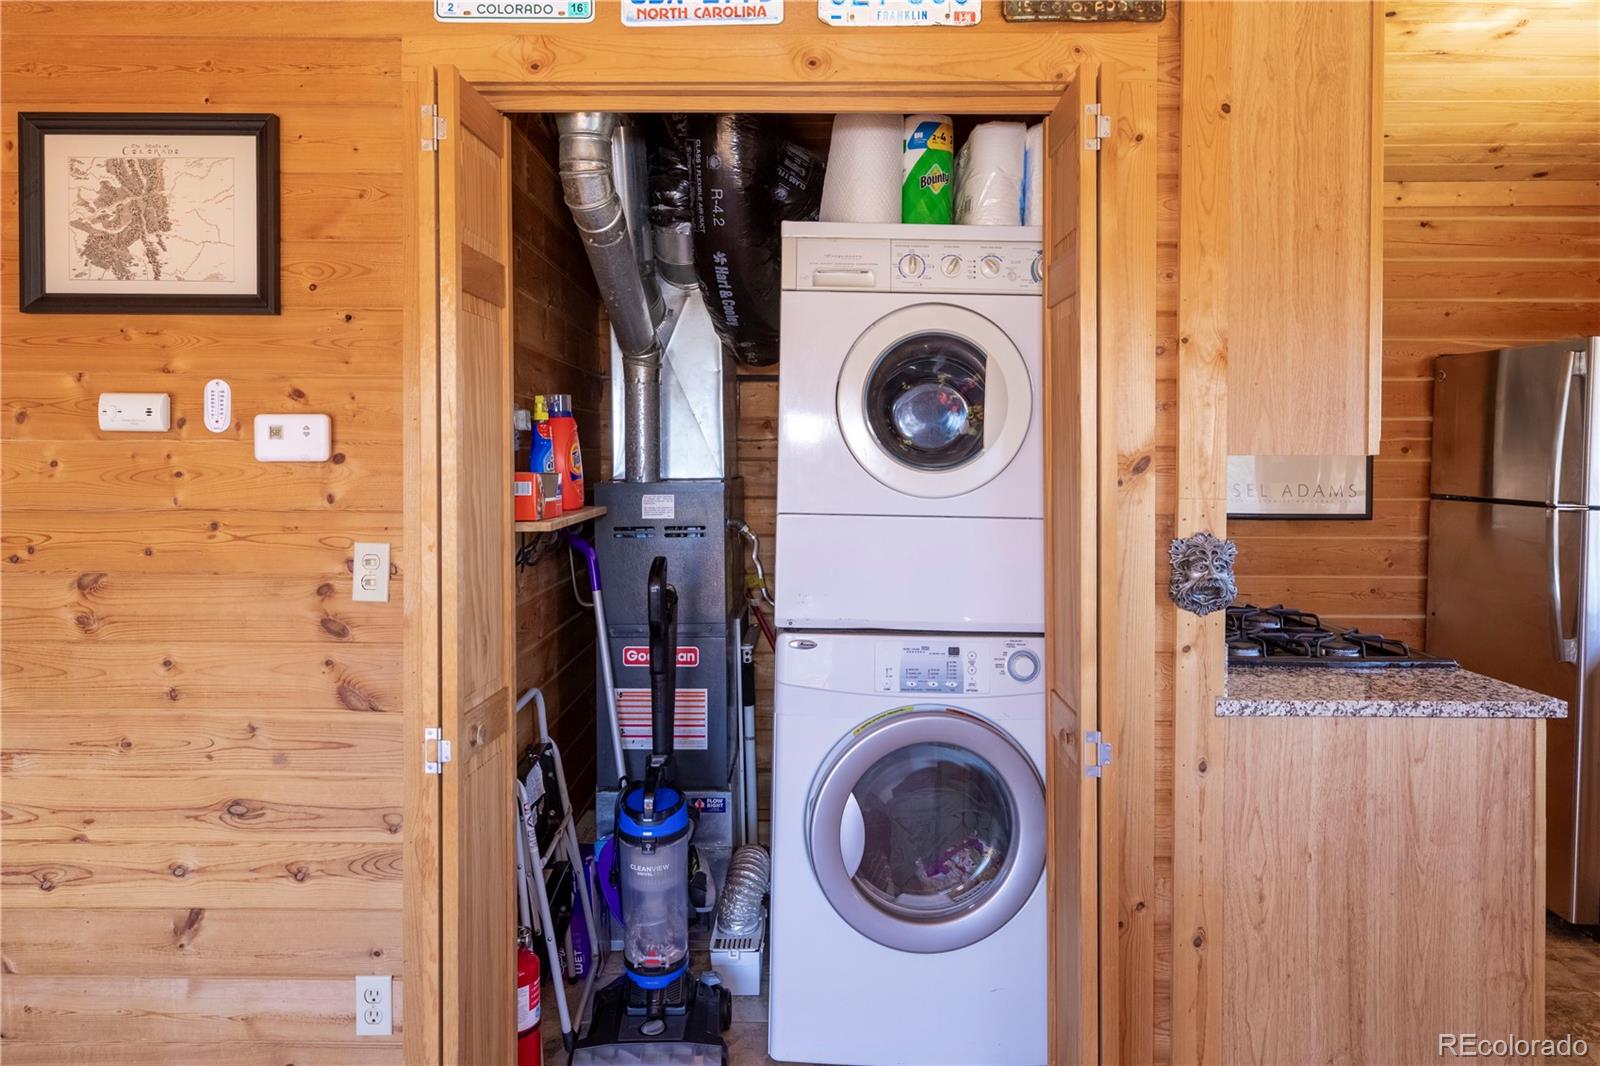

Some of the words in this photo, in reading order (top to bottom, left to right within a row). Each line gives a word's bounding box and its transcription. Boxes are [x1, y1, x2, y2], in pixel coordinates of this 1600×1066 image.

[447, 2, 454, 12] 2
[476, 3, 554, 15] COLORADO
[570, 3, 584, 13] 16
[636, 7, 688, 20] NORTH
[694, 5, 767, 18] CAROLINA
[876, 10, 928, 20] FRANKLIN
[920, 172, 949, 189] Bounty
[710, 188, 725, 227] R-4.2
[714, 266, 732, 289] Hart
[719, 290, 733, 299] &
[1281, 483, 1358, 498] ADAMS
[626, 650, 696, 662] Goan
[629, 863, 670, 872] CLEANVIEW
